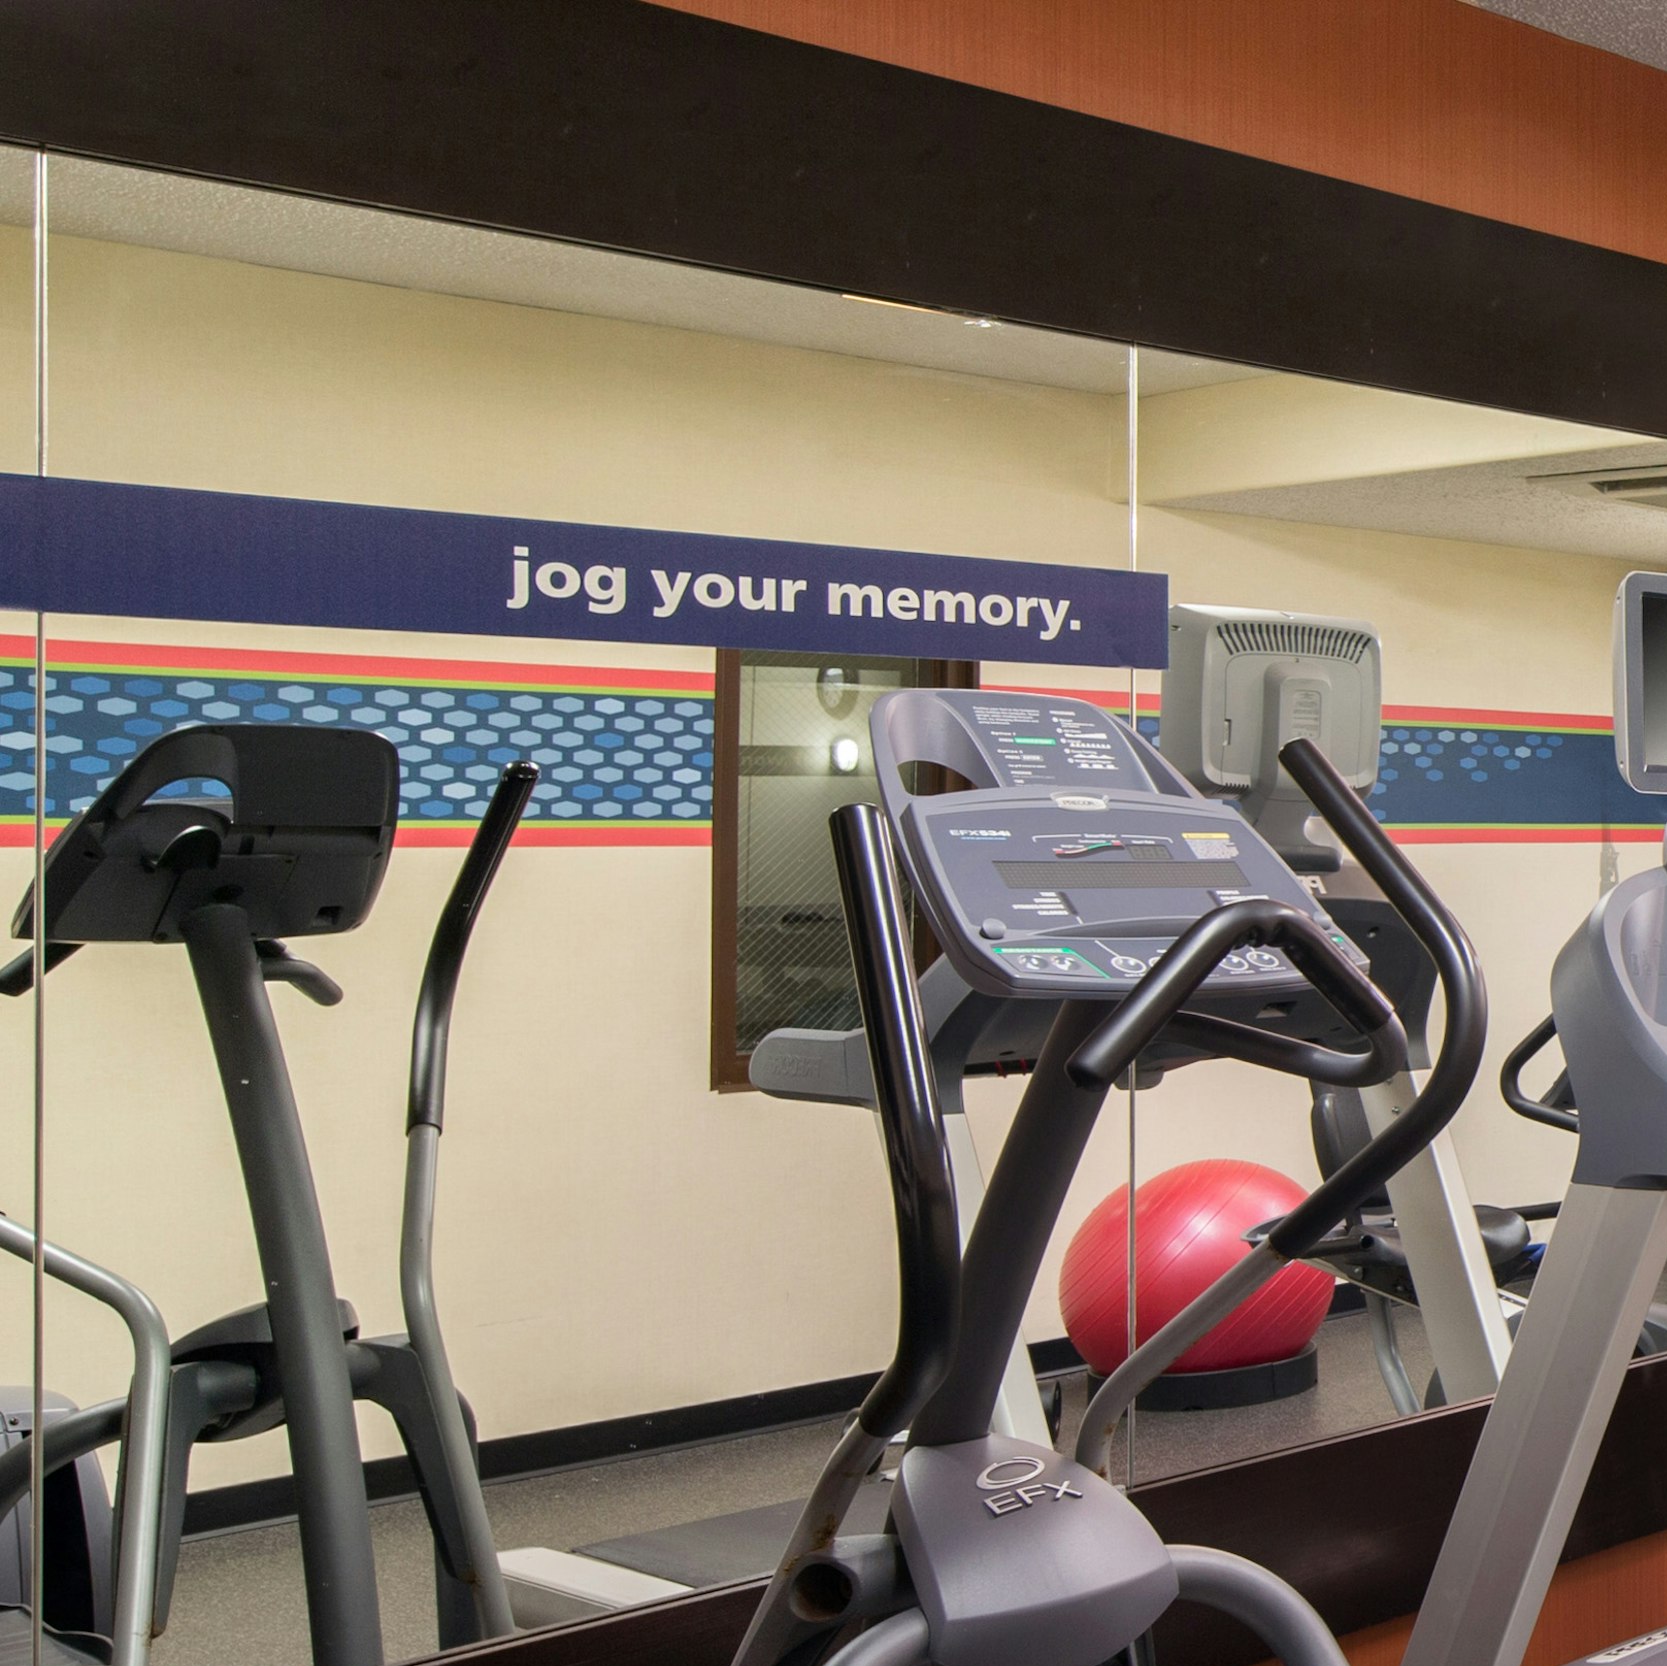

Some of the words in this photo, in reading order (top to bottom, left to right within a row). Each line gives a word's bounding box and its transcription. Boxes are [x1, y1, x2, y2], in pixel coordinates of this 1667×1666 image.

[507, 546, 627, 615] jog
[651, 567, 807, 618] your
[828, 580, 1082, 641] memory.
[983, 1479, 1083, 1518] EFX
